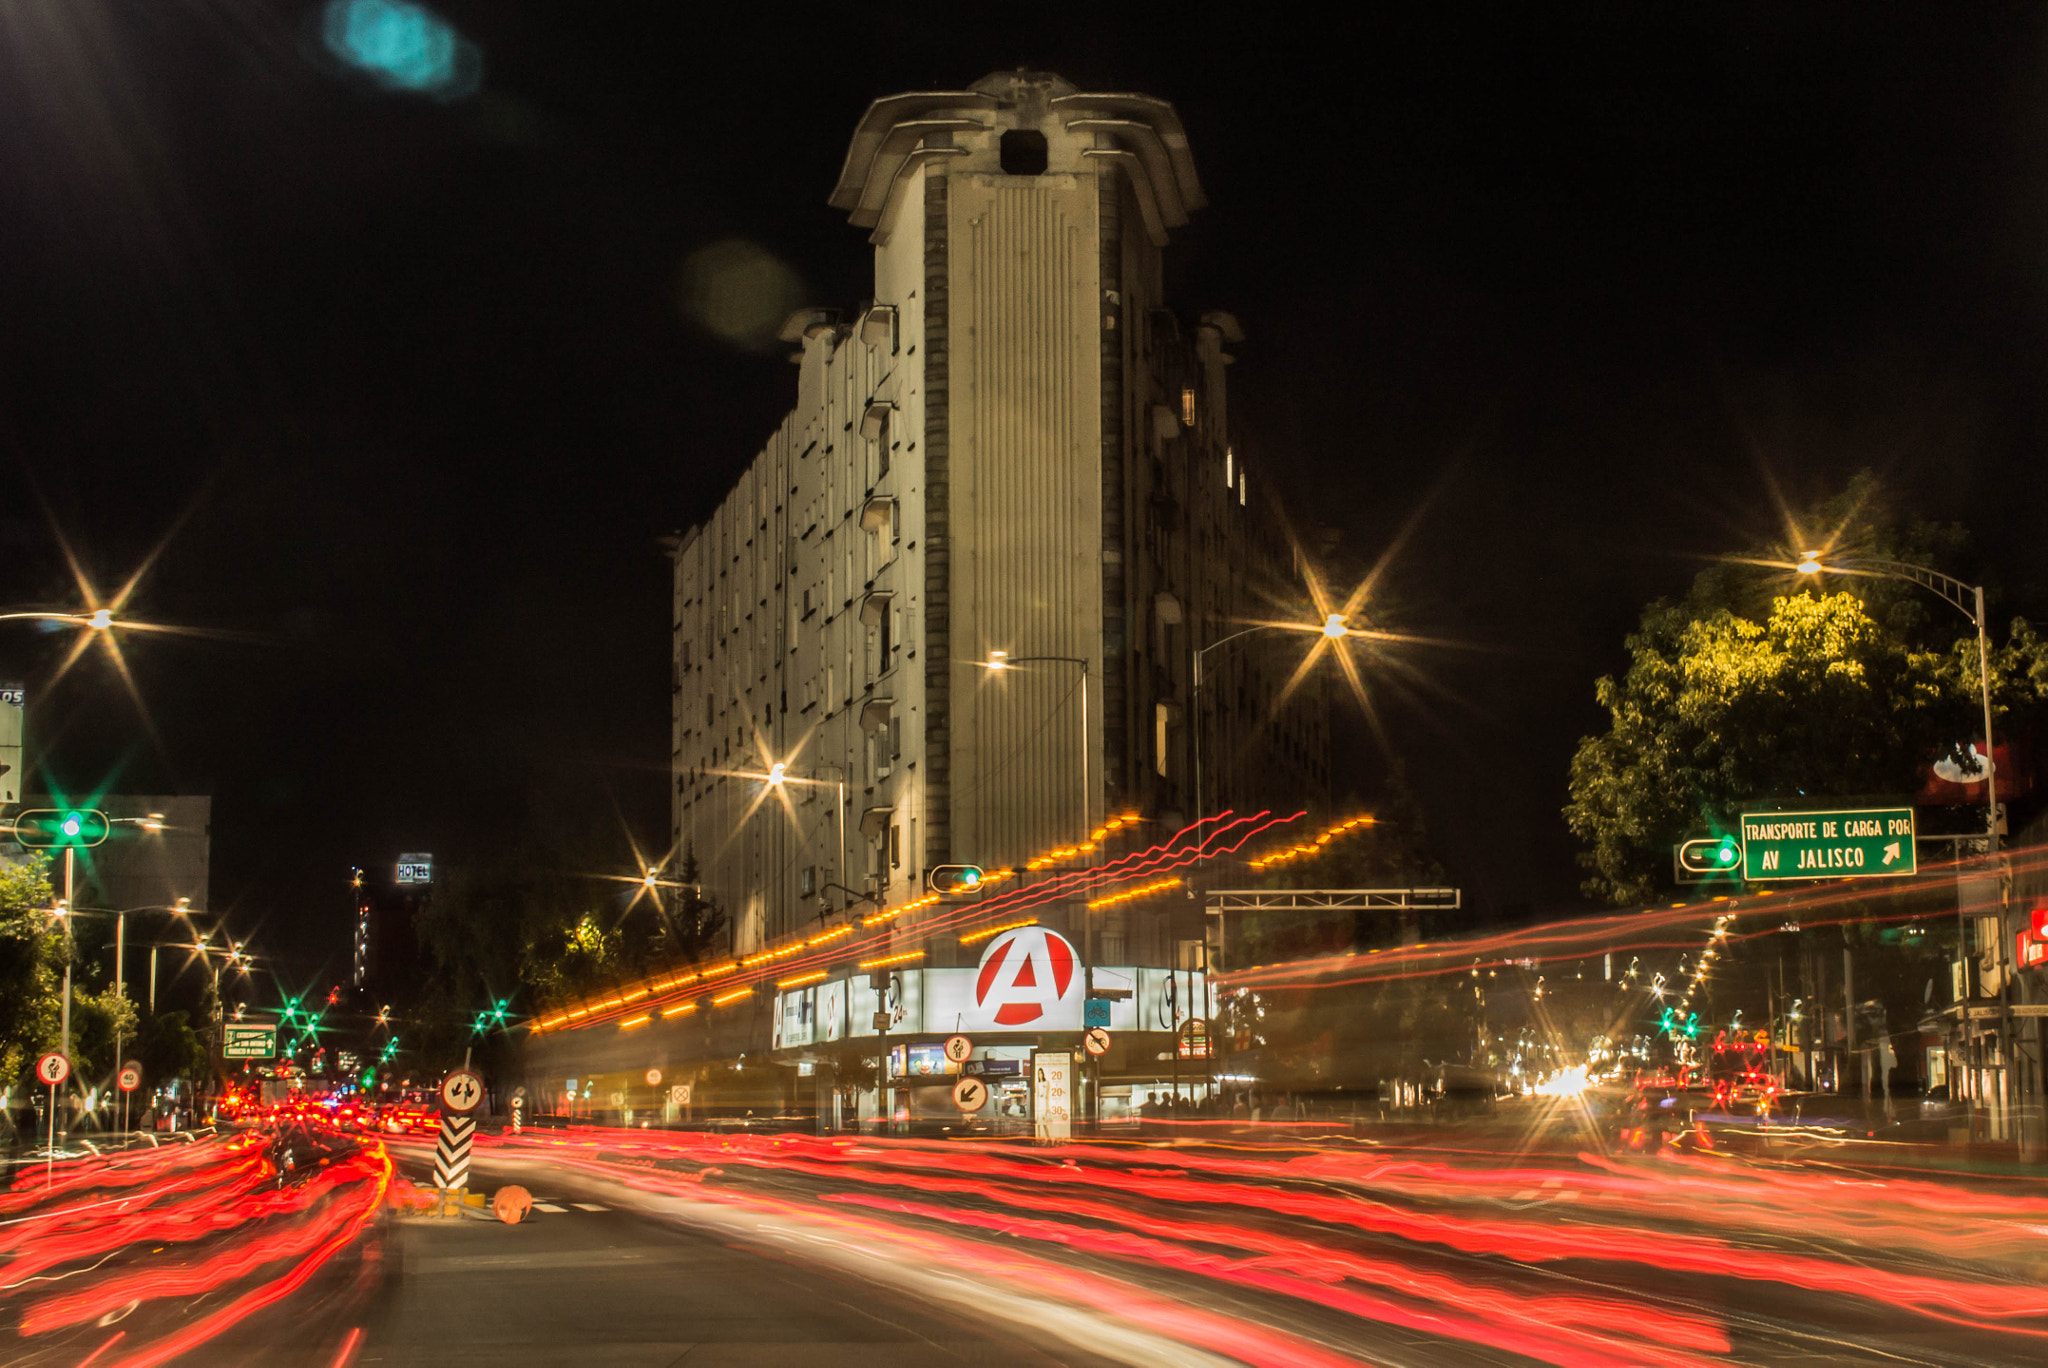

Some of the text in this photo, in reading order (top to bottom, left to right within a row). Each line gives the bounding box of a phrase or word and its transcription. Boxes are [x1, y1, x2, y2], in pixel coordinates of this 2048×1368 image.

[1745, 819, 1911, 840] TRANSPORTE DE CARGA POR
[1762, 847, 1865, 870] AV JALISCO
[398, 865, 428, 877] HOTEL
[1051, 1071, 1062, 1080] 20
